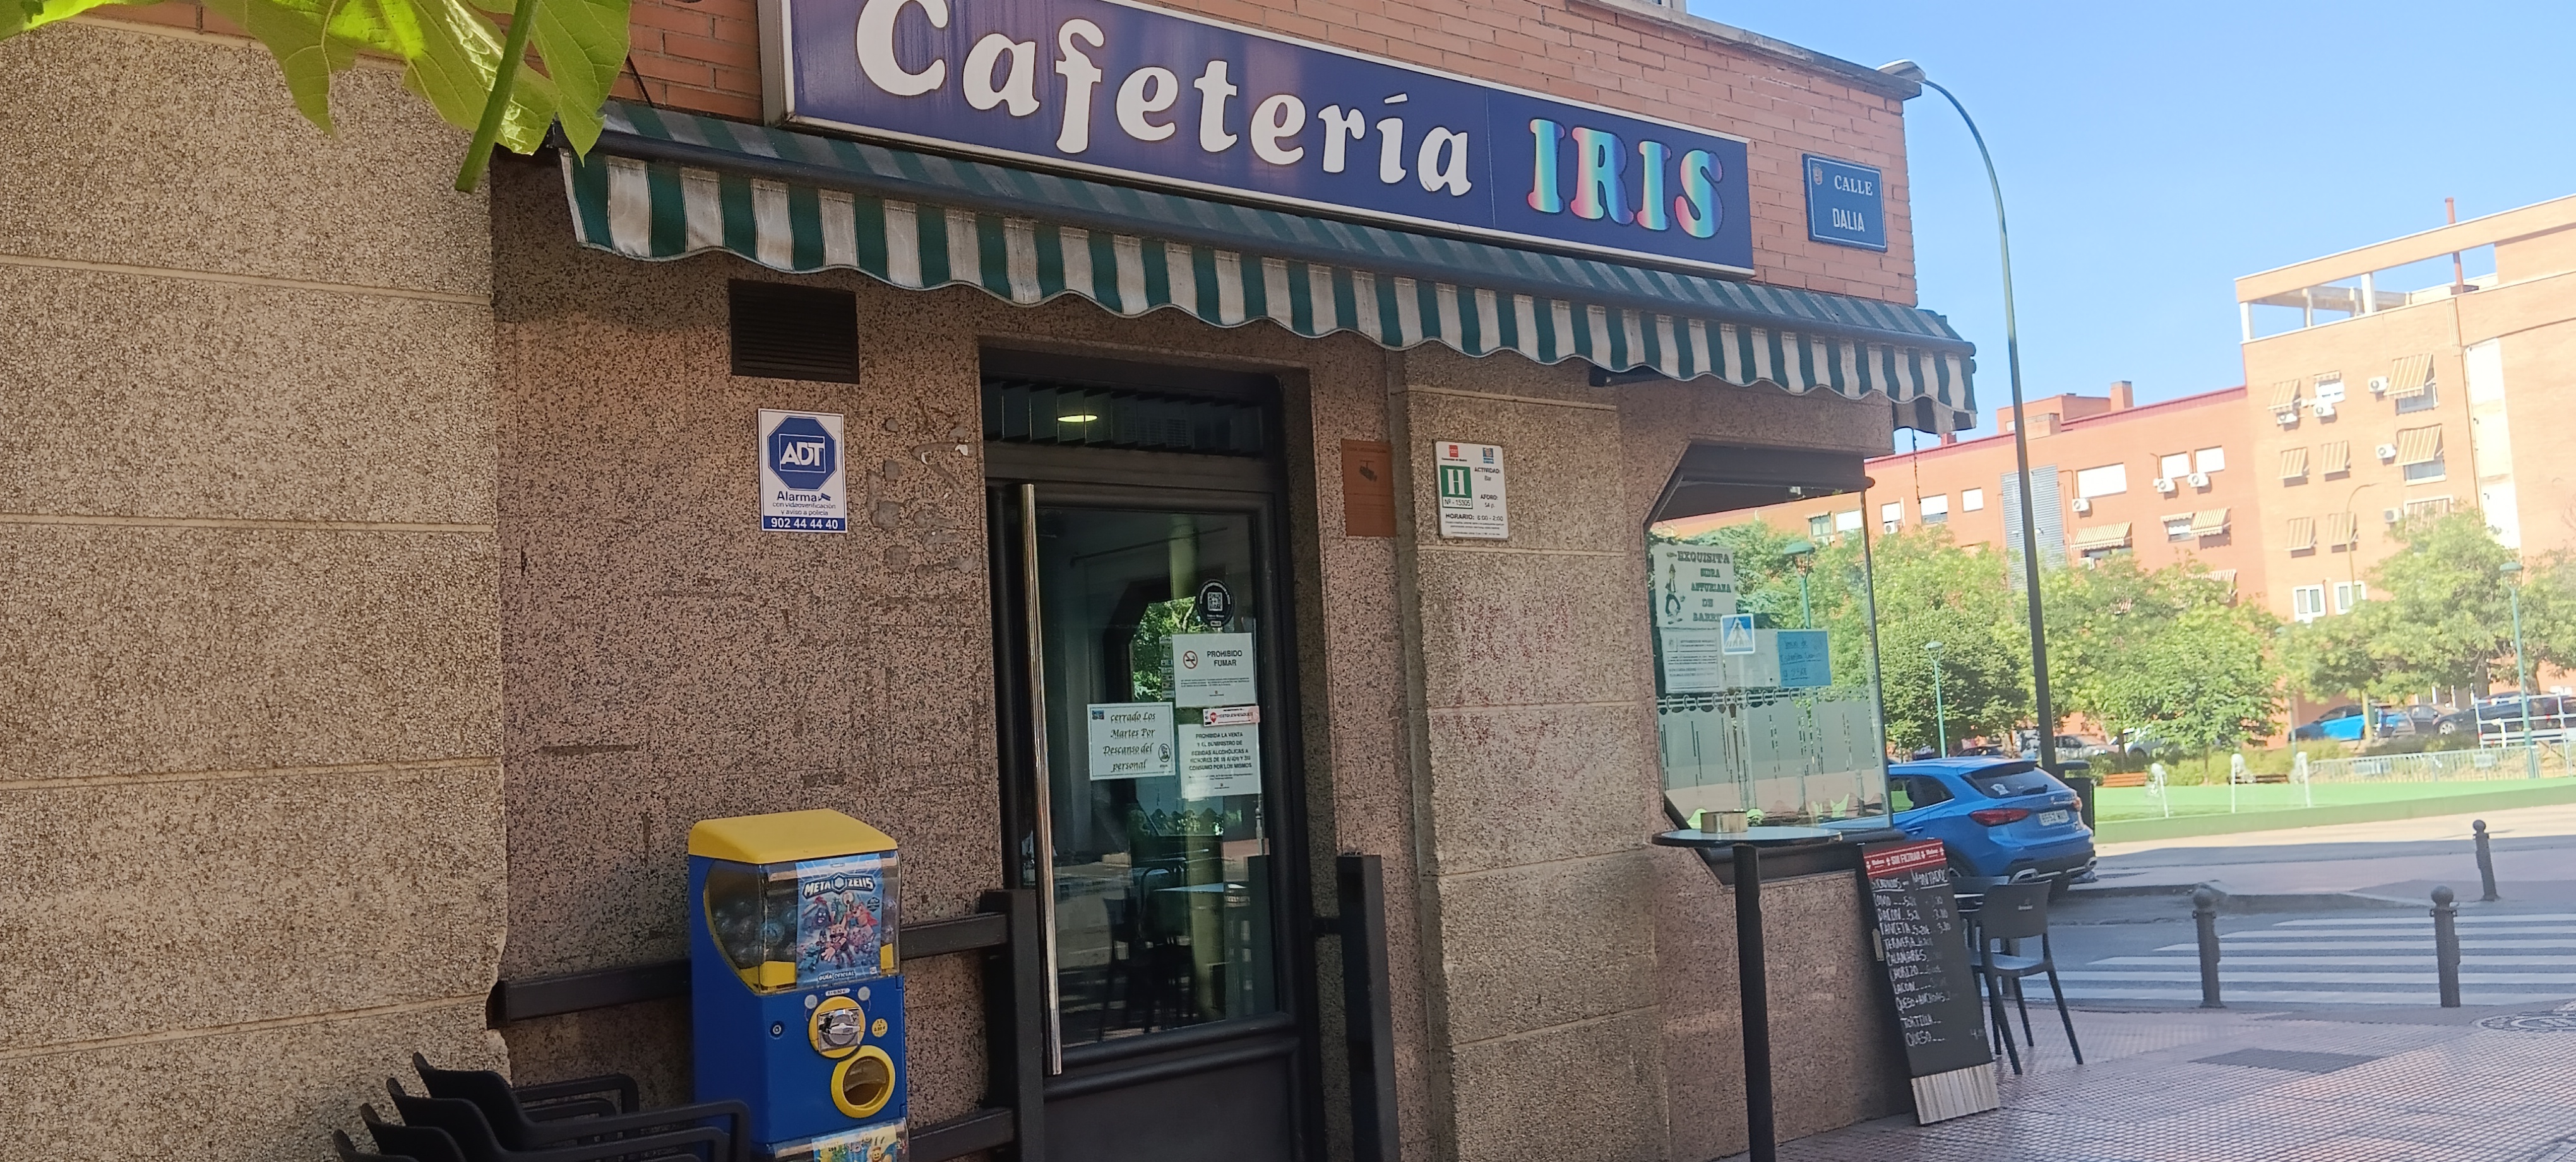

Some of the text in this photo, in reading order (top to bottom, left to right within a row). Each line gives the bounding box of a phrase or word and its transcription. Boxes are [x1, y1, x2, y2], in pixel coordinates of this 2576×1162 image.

[856, 0, 1725, 238] Cafetería IRIS
[1834, 175, 1873, 196] CALLE
[1832, 208, 1865, 232] DALIA
[780, 441, 824, 466] ADT
[1446, 469, 1466, 496] H
[777, 491, 817, 502] Alarma
[771, 517, 838, 529] 902 44 44 40
[1677, 551, 1730, 564] EXQUISITA
[1111, 711, 1156, 721] cerrado Los
[1110, 729, 1139, 738] Martes
[1102, 743, 1154, 755] Descanso del
[1111, 759, 1147, 773] personal
